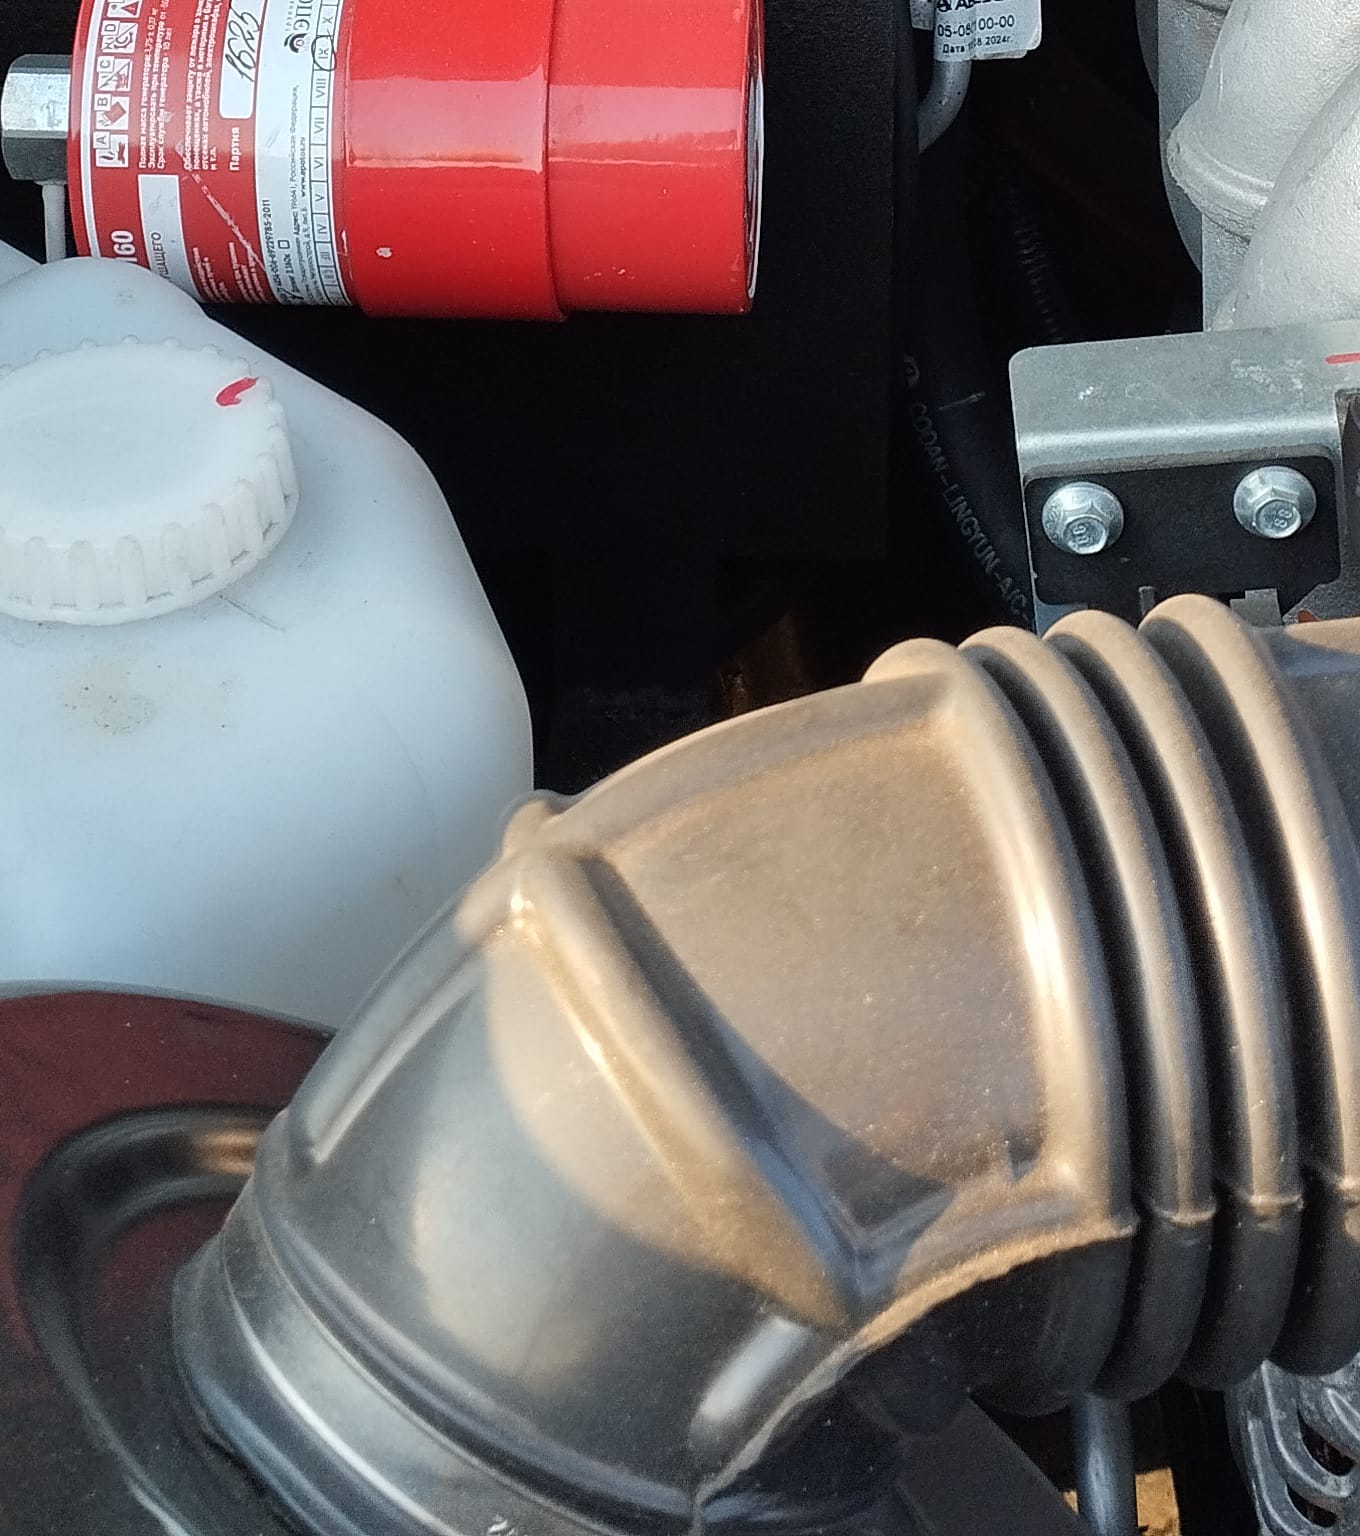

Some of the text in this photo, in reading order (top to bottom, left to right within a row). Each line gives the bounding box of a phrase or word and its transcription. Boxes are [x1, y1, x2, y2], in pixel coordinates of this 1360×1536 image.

[322, 15, 333, 24] X
[104, 22, 115, 32] D
[224, 8, 260, 81] 1625
[99, 59, 111, 68] C
[97, 96, 108, 107] B
[311, 115, 325, 135] VII
[94, 135, 105, 144] A
[229, 126, 241, 170] Партия
[313, 155, 325, 168] VI
[313, 192, 324, 202] V
